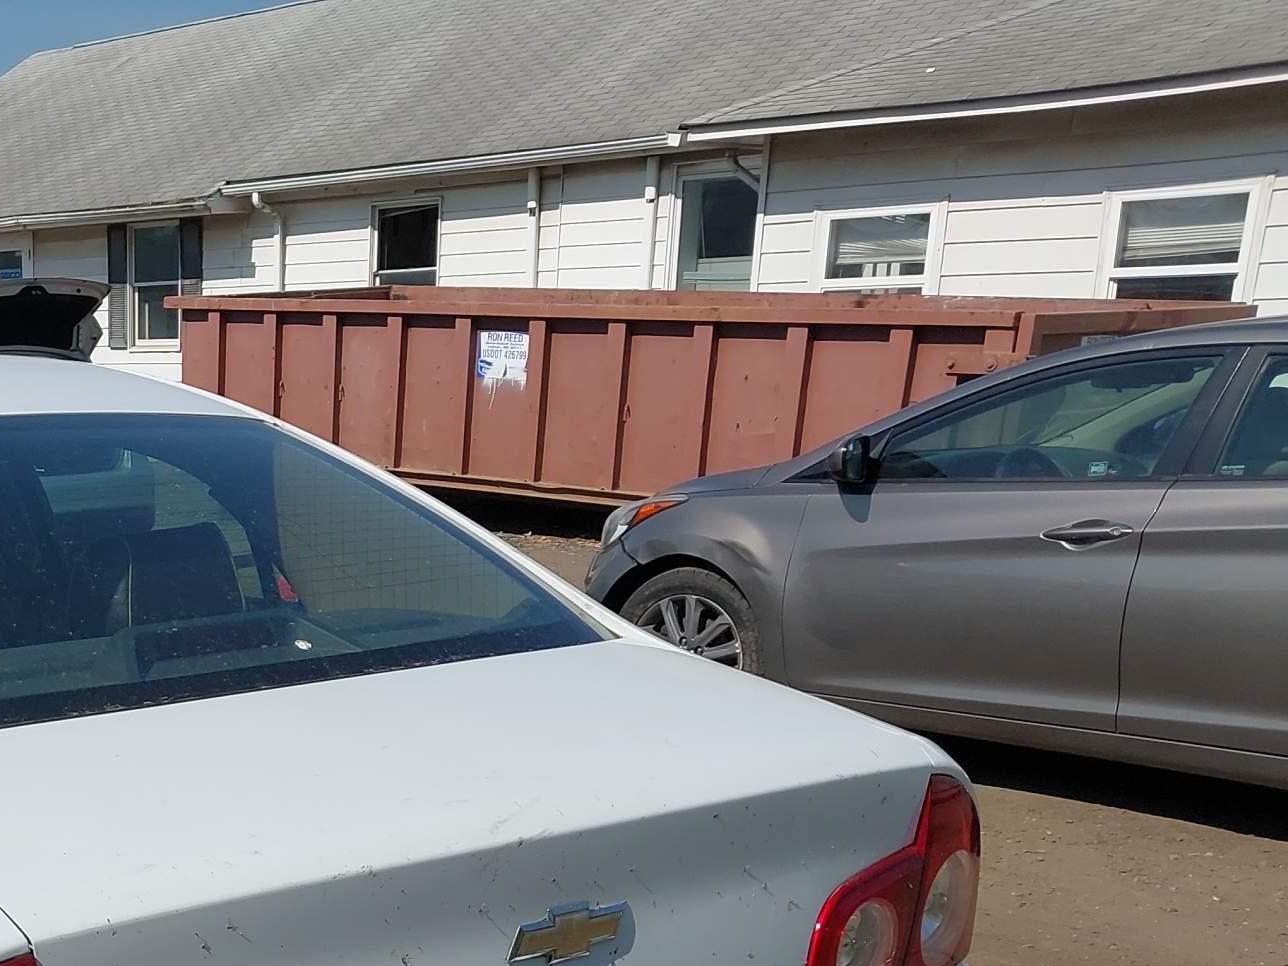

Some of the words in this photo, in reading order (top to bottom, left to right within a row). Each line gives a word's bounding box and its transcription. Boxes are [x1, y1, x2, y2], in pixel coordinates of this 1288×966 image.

[487, 332, 503, 342] RON
[503, 333, 524, 343] REED
[482, 349, 503, 359] USDOT
